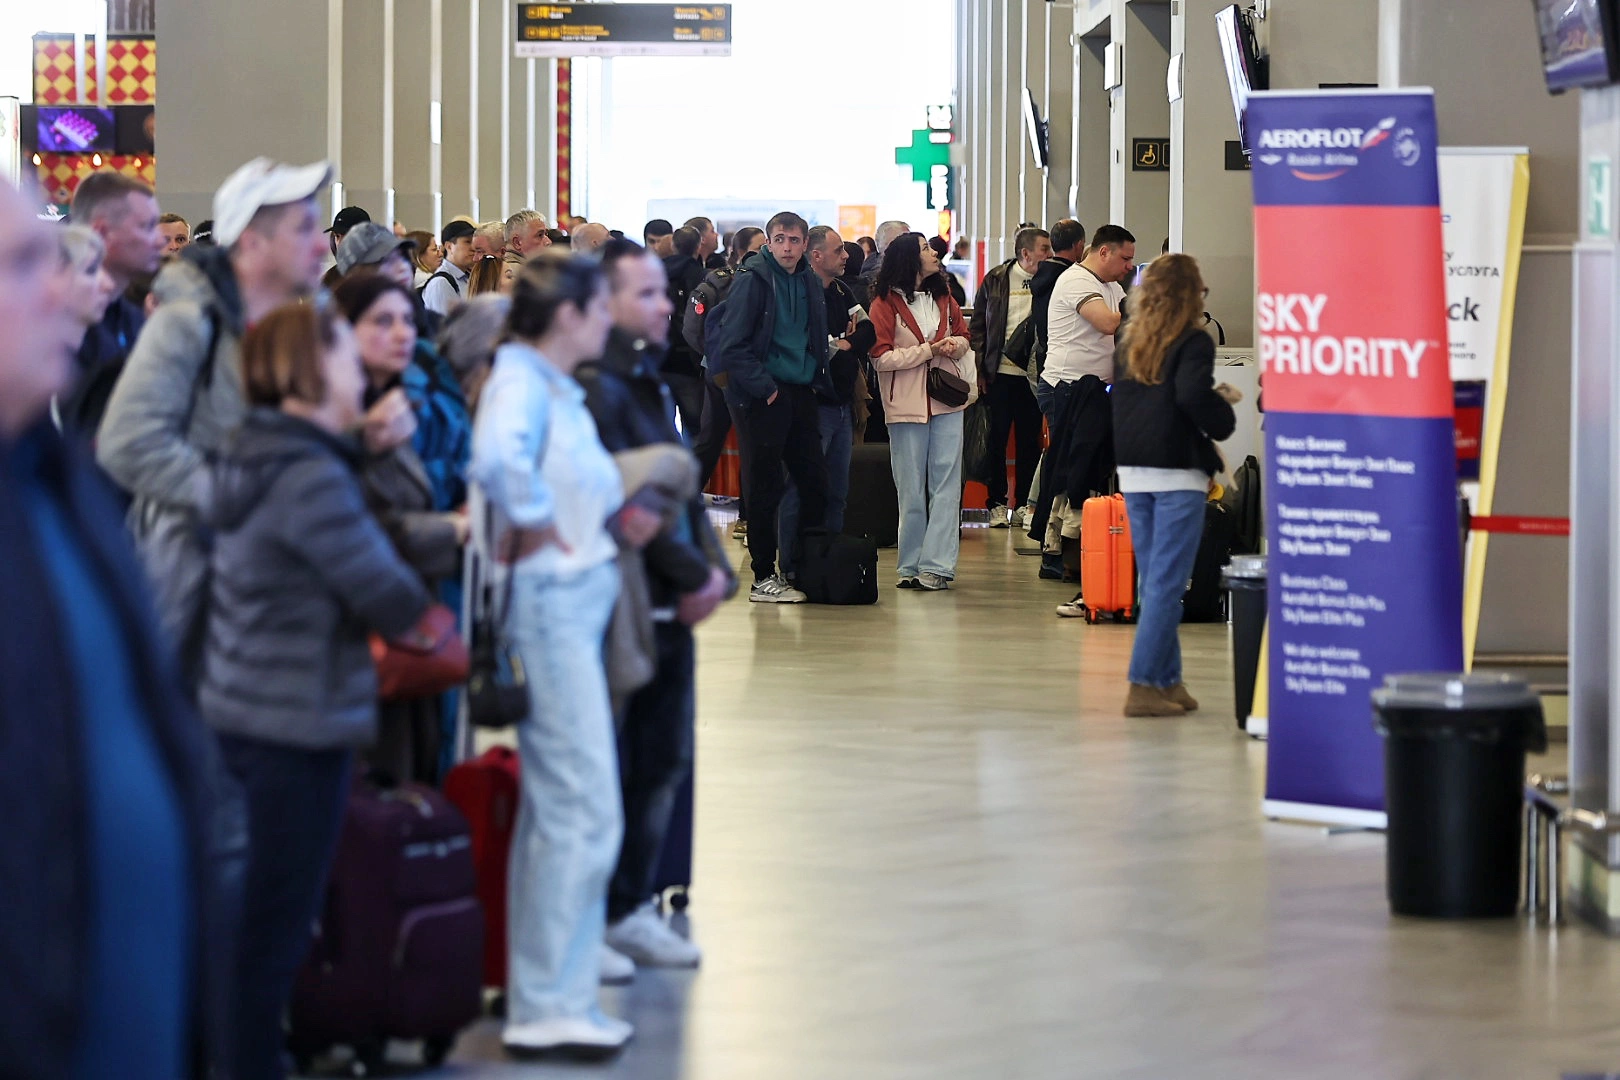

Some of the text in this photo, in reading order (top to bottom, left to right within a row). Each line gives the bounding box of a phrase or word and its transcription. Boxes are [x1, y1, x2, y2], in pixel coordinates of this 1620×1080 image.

[1259, 128, 1363, 148] AEROFLOT
[1448, 266, 1500, 277] УСЛУГА
[1258, 292, 1327, 332] SKY
[1259, 335, 1427, 379] PRIORITY
